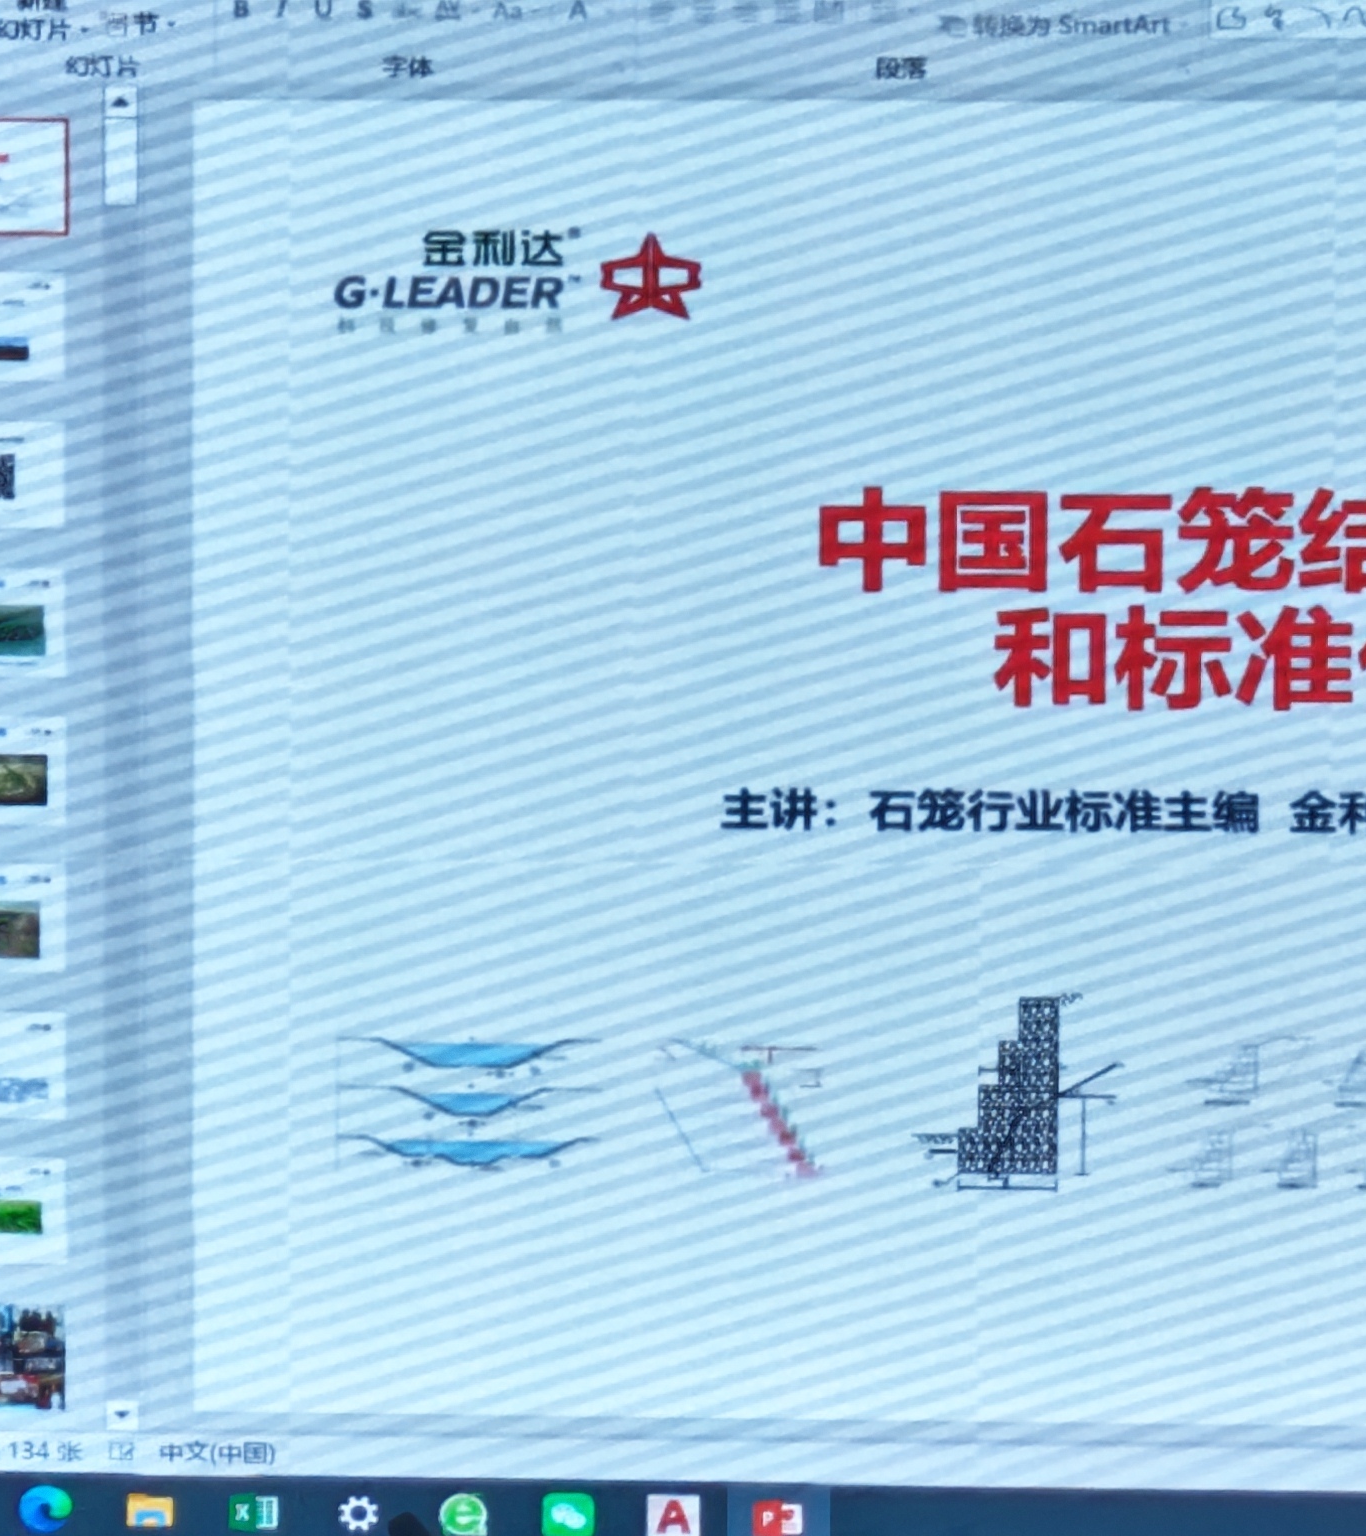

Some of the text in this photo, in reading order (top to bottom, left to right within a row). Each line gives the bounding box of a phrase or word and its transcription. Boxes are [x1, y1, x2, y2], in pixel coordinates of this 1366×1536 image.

[1058, 14, 1172, 36] SmartArt
[65, 55, 141, 78] 幻灯片
[382, 55, 434, 79] 字体
[875, 56, 929, 80] 段落
[423, 229, 565, 267] 金利达
[9, 1440, 51, 1460] 134
[159, 1440, 277, 1465] 中文(中国)
